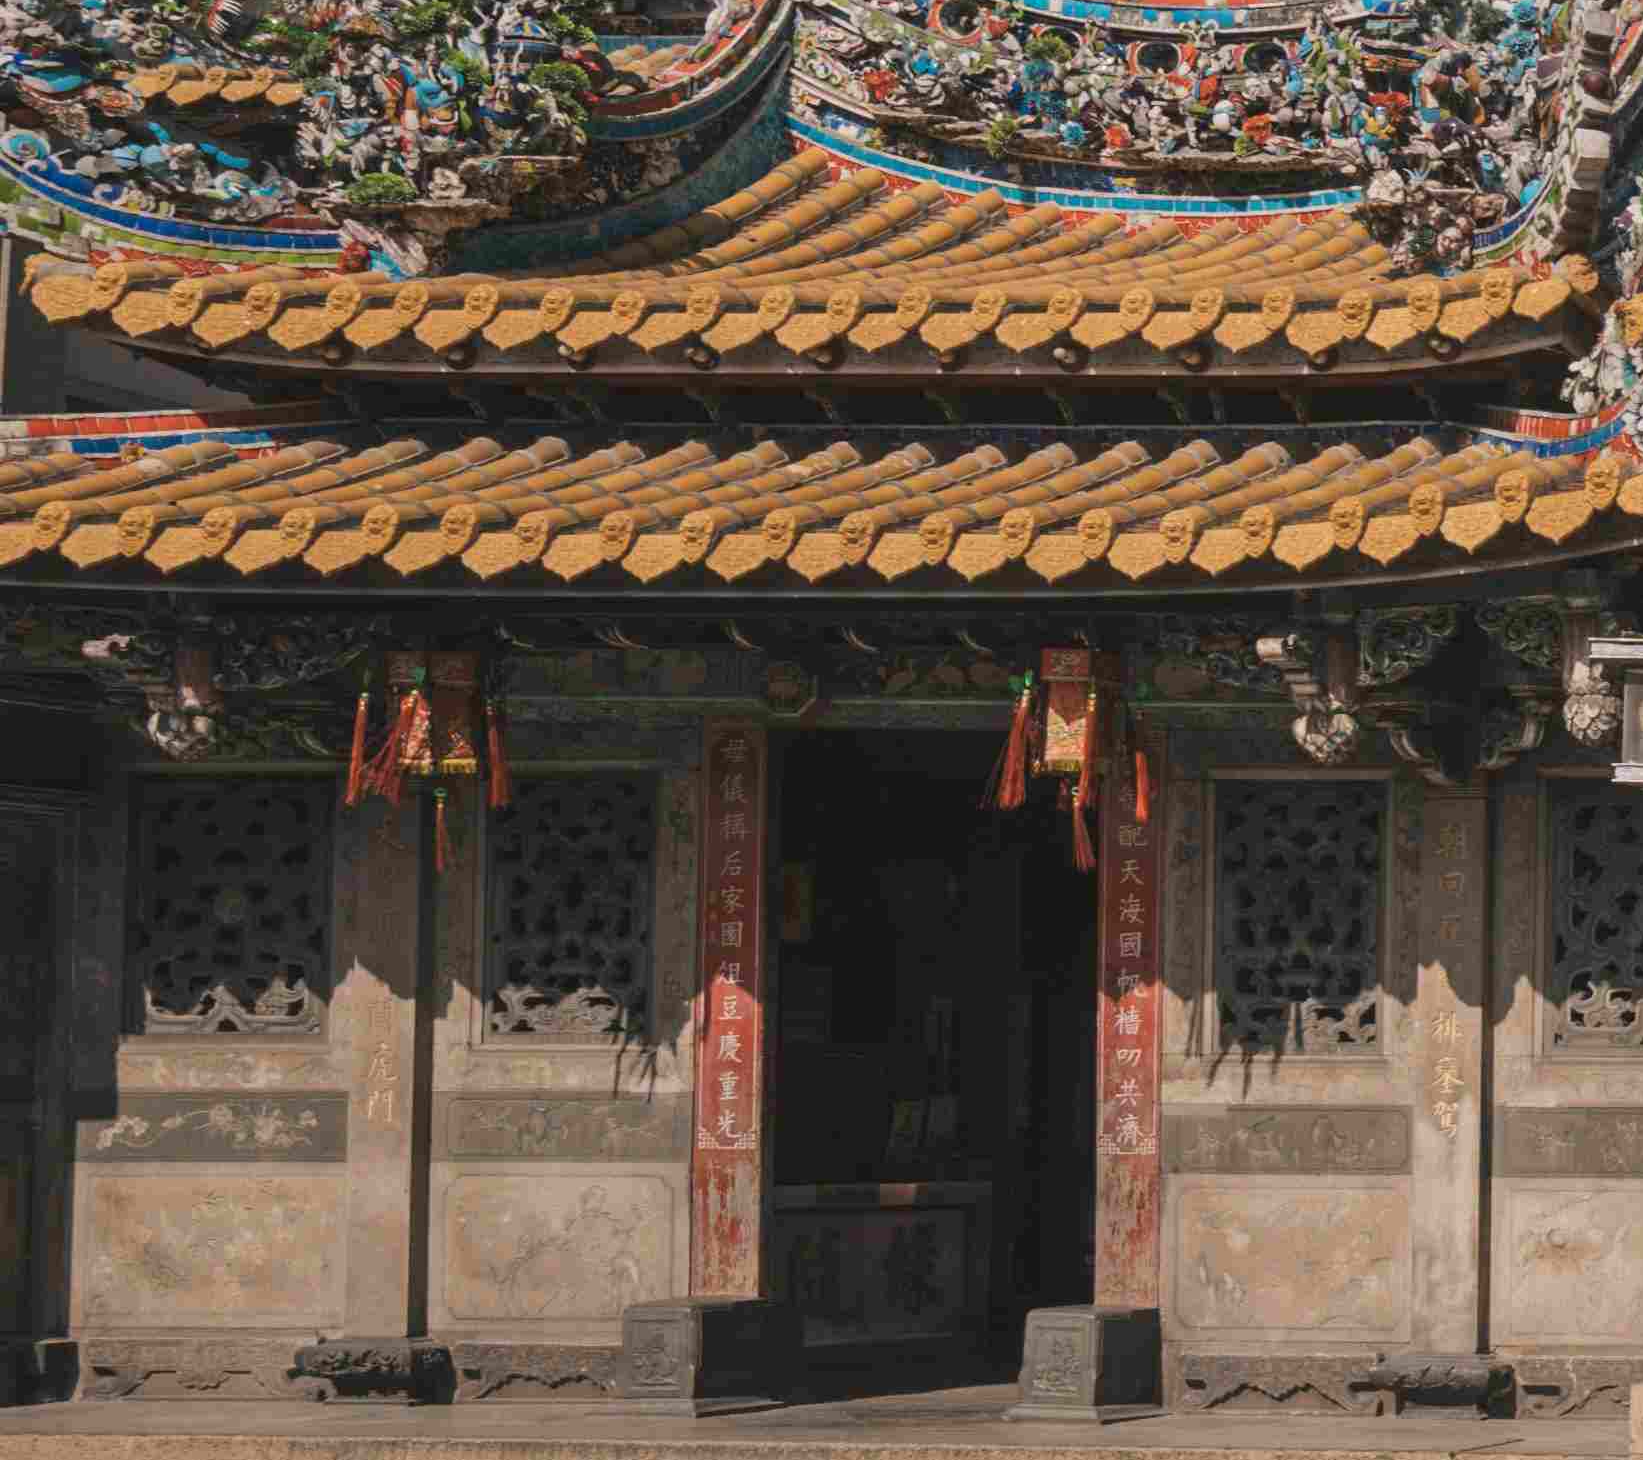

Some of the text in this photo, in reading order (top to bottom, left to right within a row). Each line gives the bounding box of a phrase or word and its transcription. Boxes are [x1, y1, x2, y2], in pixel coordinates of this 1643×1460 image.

[1113, 743, 1148, 1147] 德配天海國帆檣叨共濟
